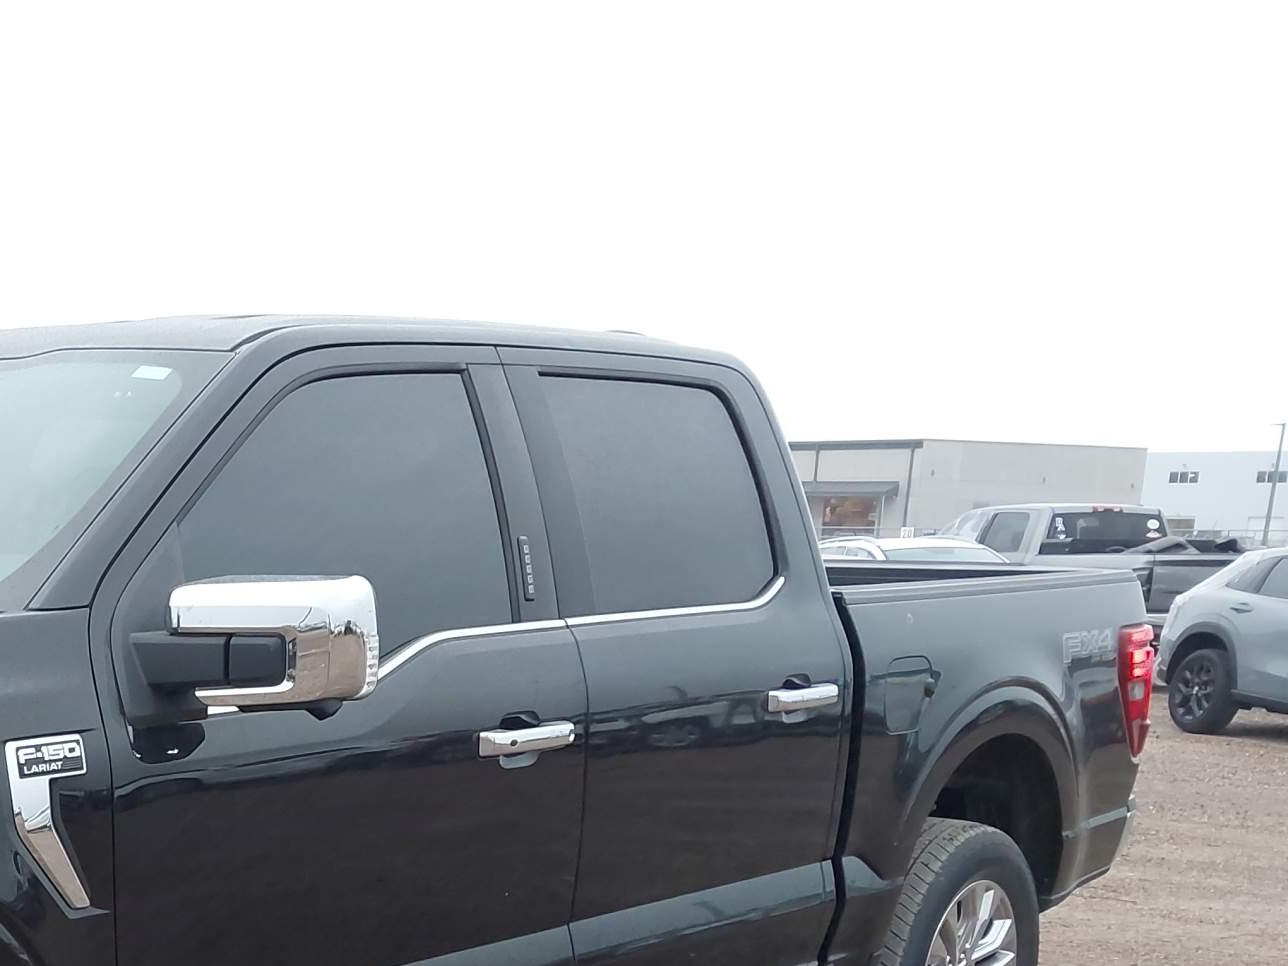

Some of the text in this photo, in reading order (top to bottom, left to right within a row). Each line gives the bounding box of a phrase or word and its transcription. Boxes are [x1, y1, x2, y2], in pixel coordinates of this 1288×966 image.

[1062, 628, 1114, 665] FX4
[17, 742, 81, 764] F-150
[23, 761, 64, 775] LARIAT
